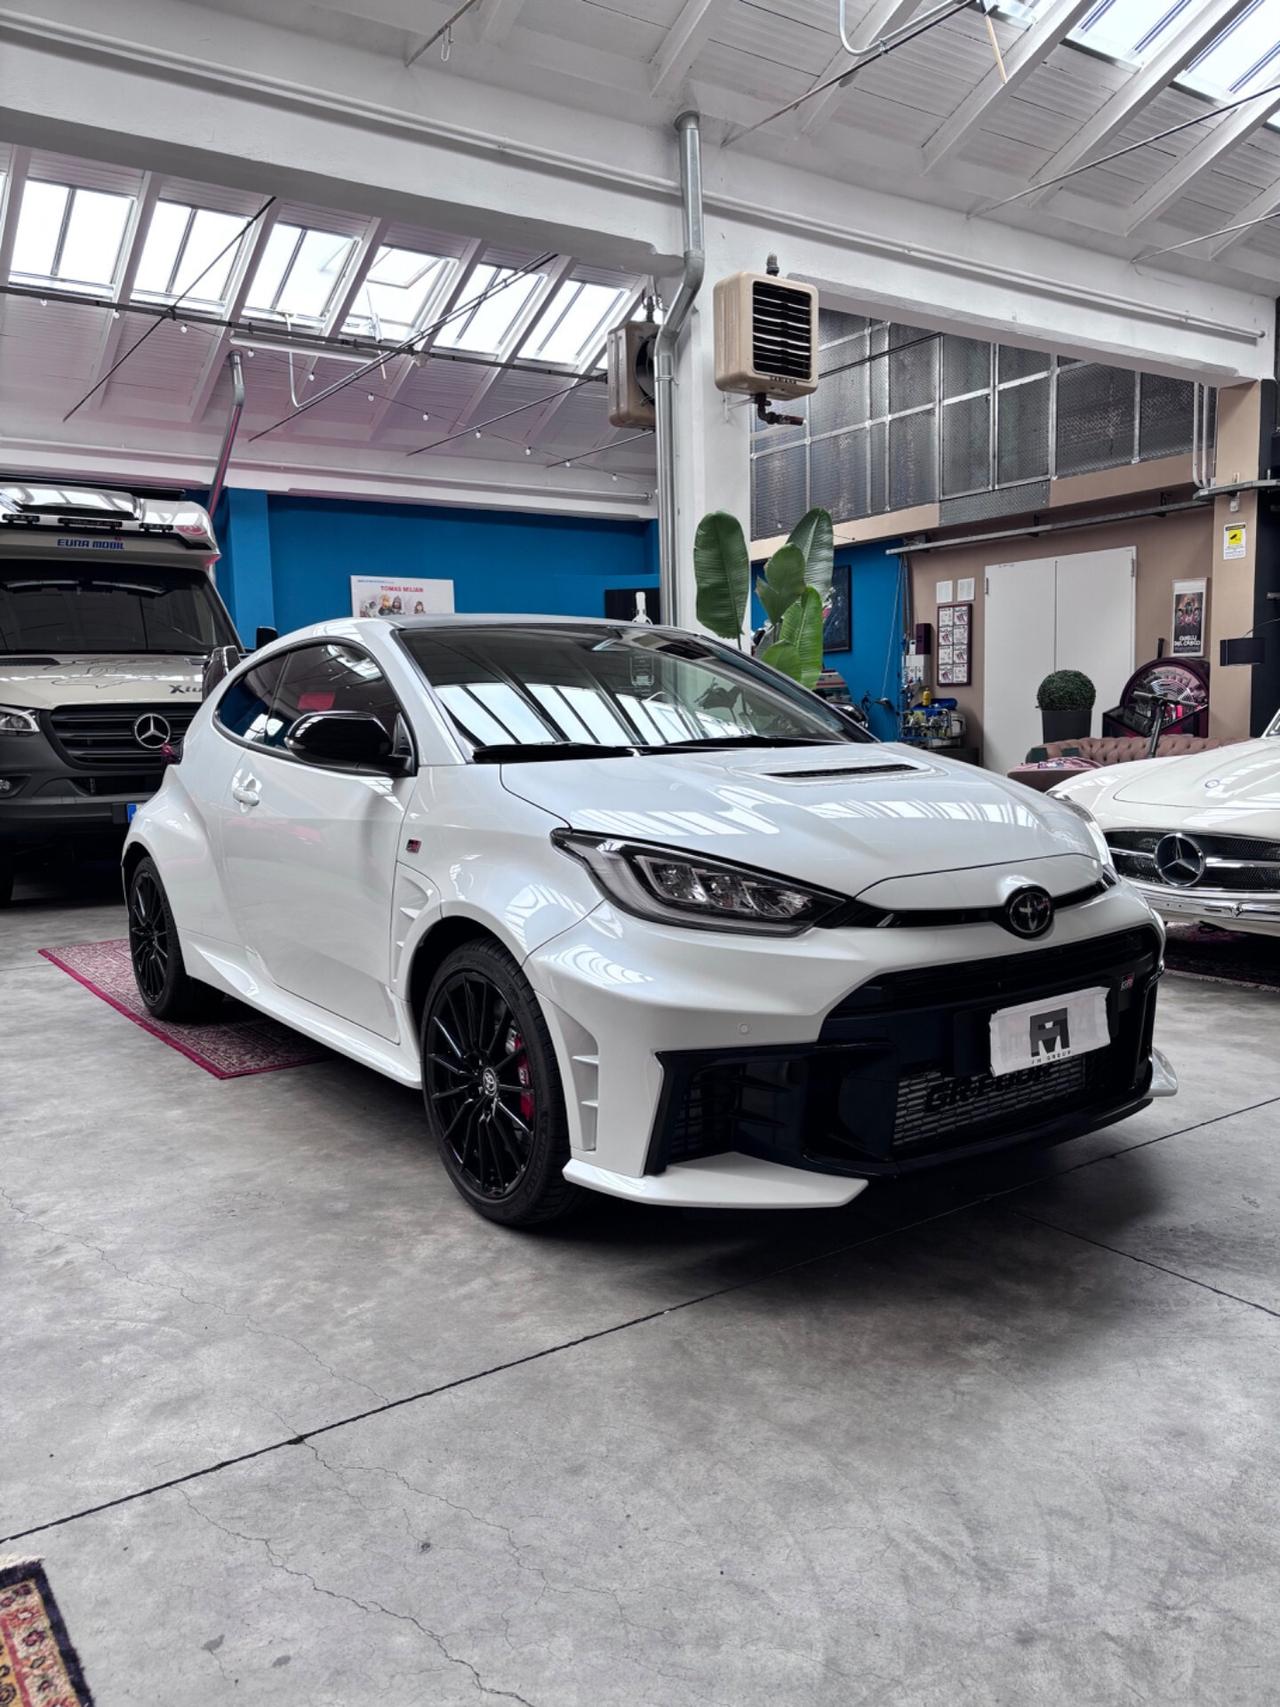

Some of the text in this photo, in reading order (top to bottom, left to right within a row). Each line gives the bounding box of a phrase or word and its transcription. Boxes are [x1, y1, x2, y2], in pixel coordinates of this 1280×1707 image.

[57, 538, 124, 549] EURA MOBIL
[168, 684, 203, 694] Xtu
